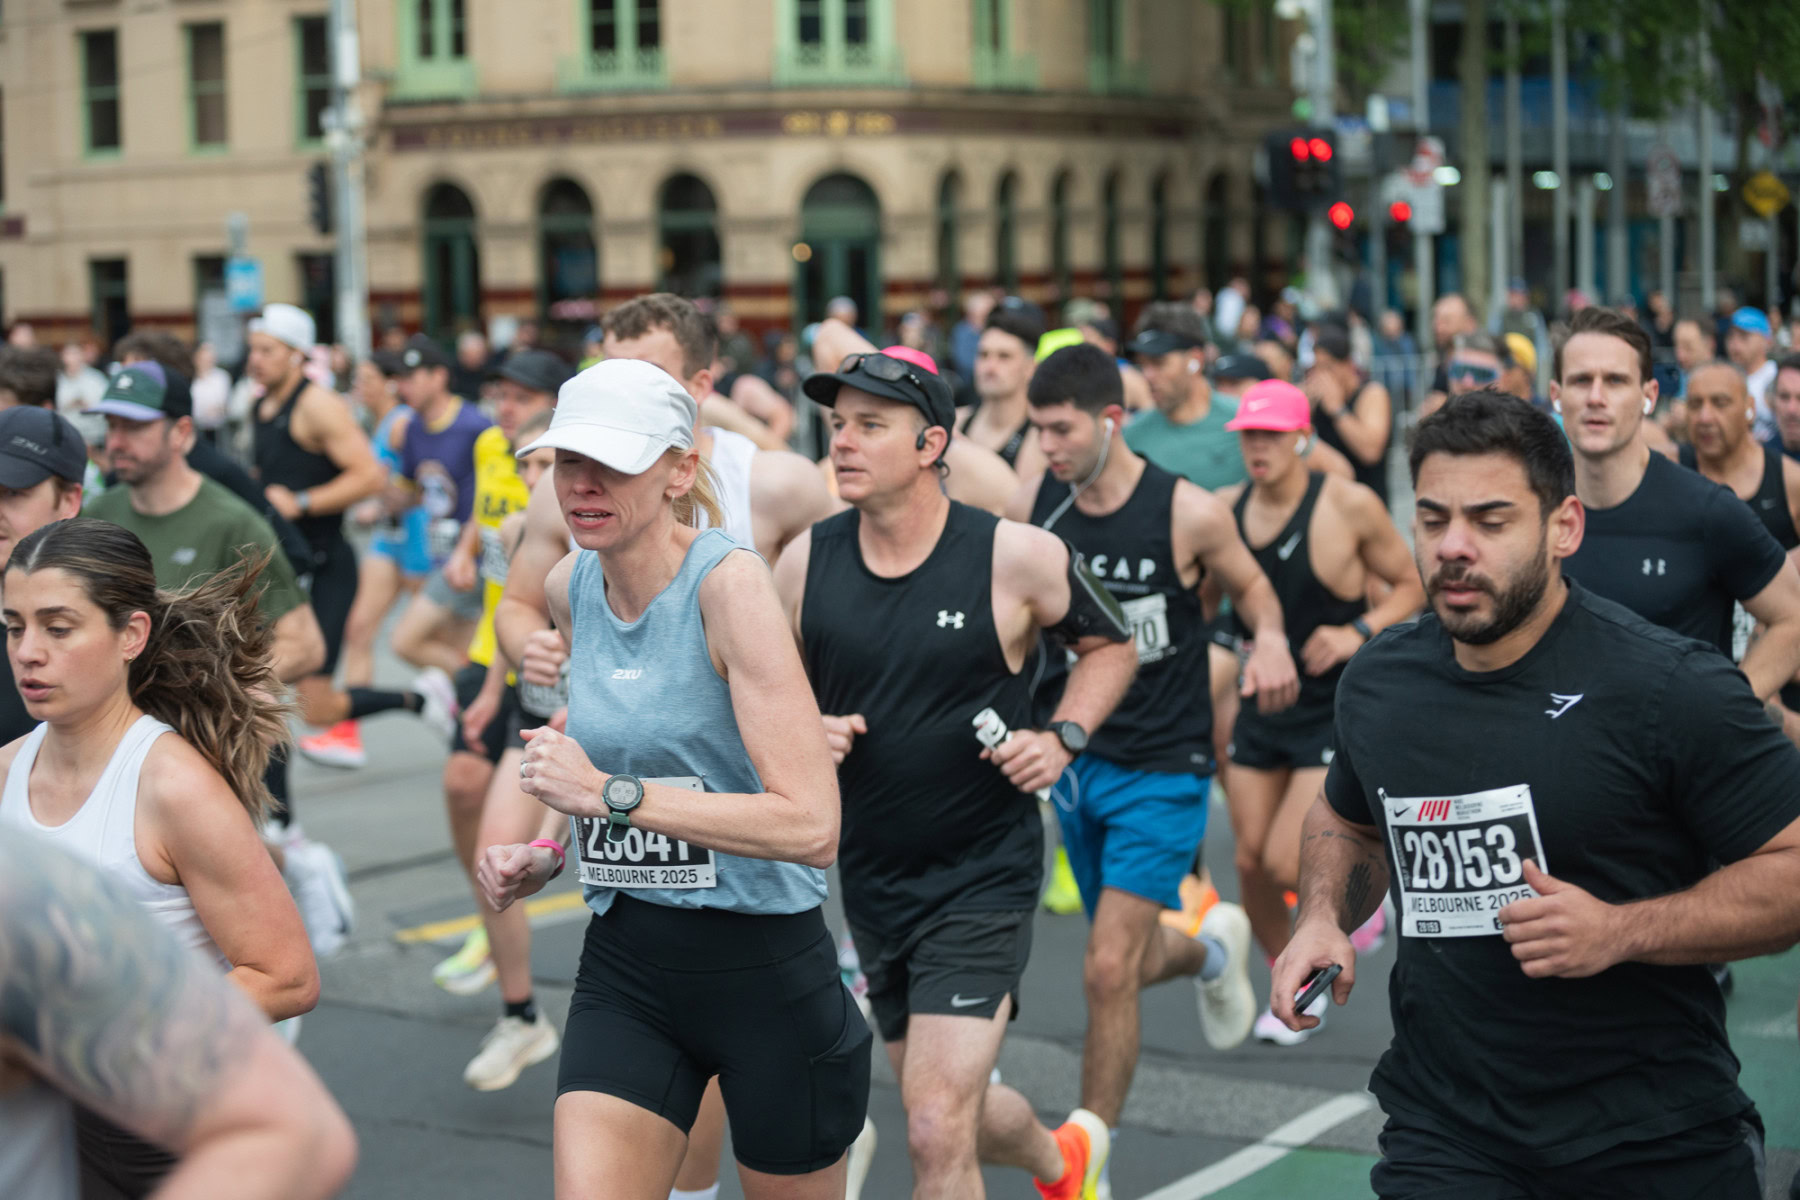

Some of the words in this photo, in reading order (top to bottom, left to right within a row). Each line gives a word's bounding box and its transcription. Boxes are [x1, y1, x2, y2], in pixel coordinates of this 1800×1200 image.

[611, 668, 642, 680] 2XU
[1404, 824, 1522, 890] 28153
[588, 866, 657, 884] MELBOURNE
[661, 869, 698, 884] 2025
[1412, 896, 1484, 913] MELBOURNE
